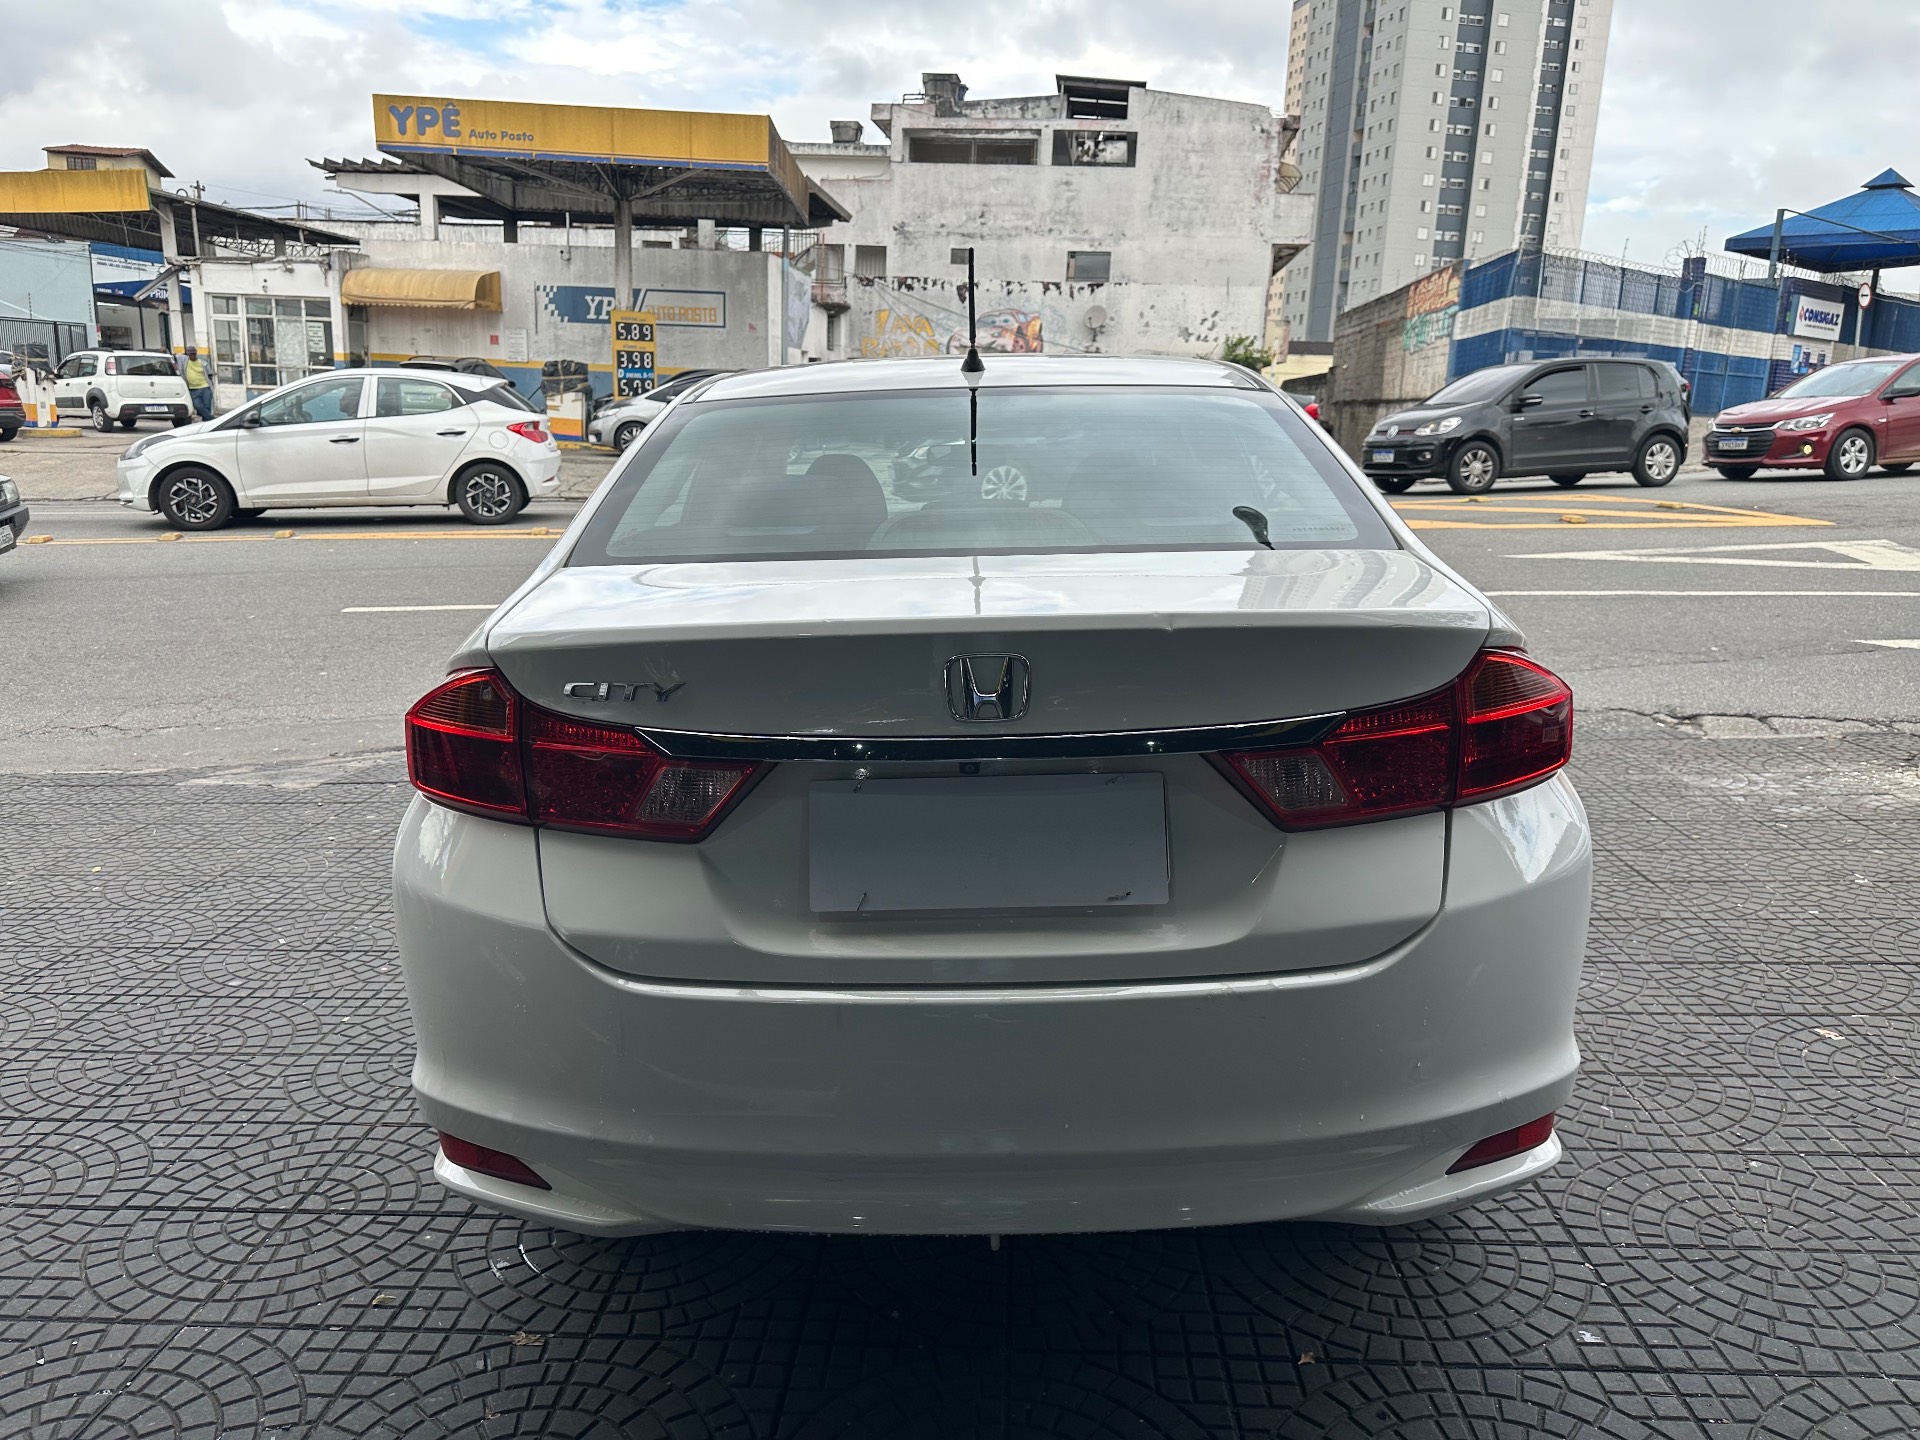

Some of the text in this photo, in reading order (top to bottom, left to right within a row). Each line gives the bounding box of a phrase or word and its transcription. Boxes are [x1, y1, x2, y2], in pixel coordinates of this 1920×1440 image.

[389, 102, 534, 142] YPÊ Auto Posto
[585, 295, 616, 320] YP
[678, 306, 717, 323] POSTO
[1804, 307, 1840, 326] CONSIGAZ
[618, 323, 651, 341] 5,89
[620, 351, 652, 369] 3,98
[563, 682, 686, 702] CITY
